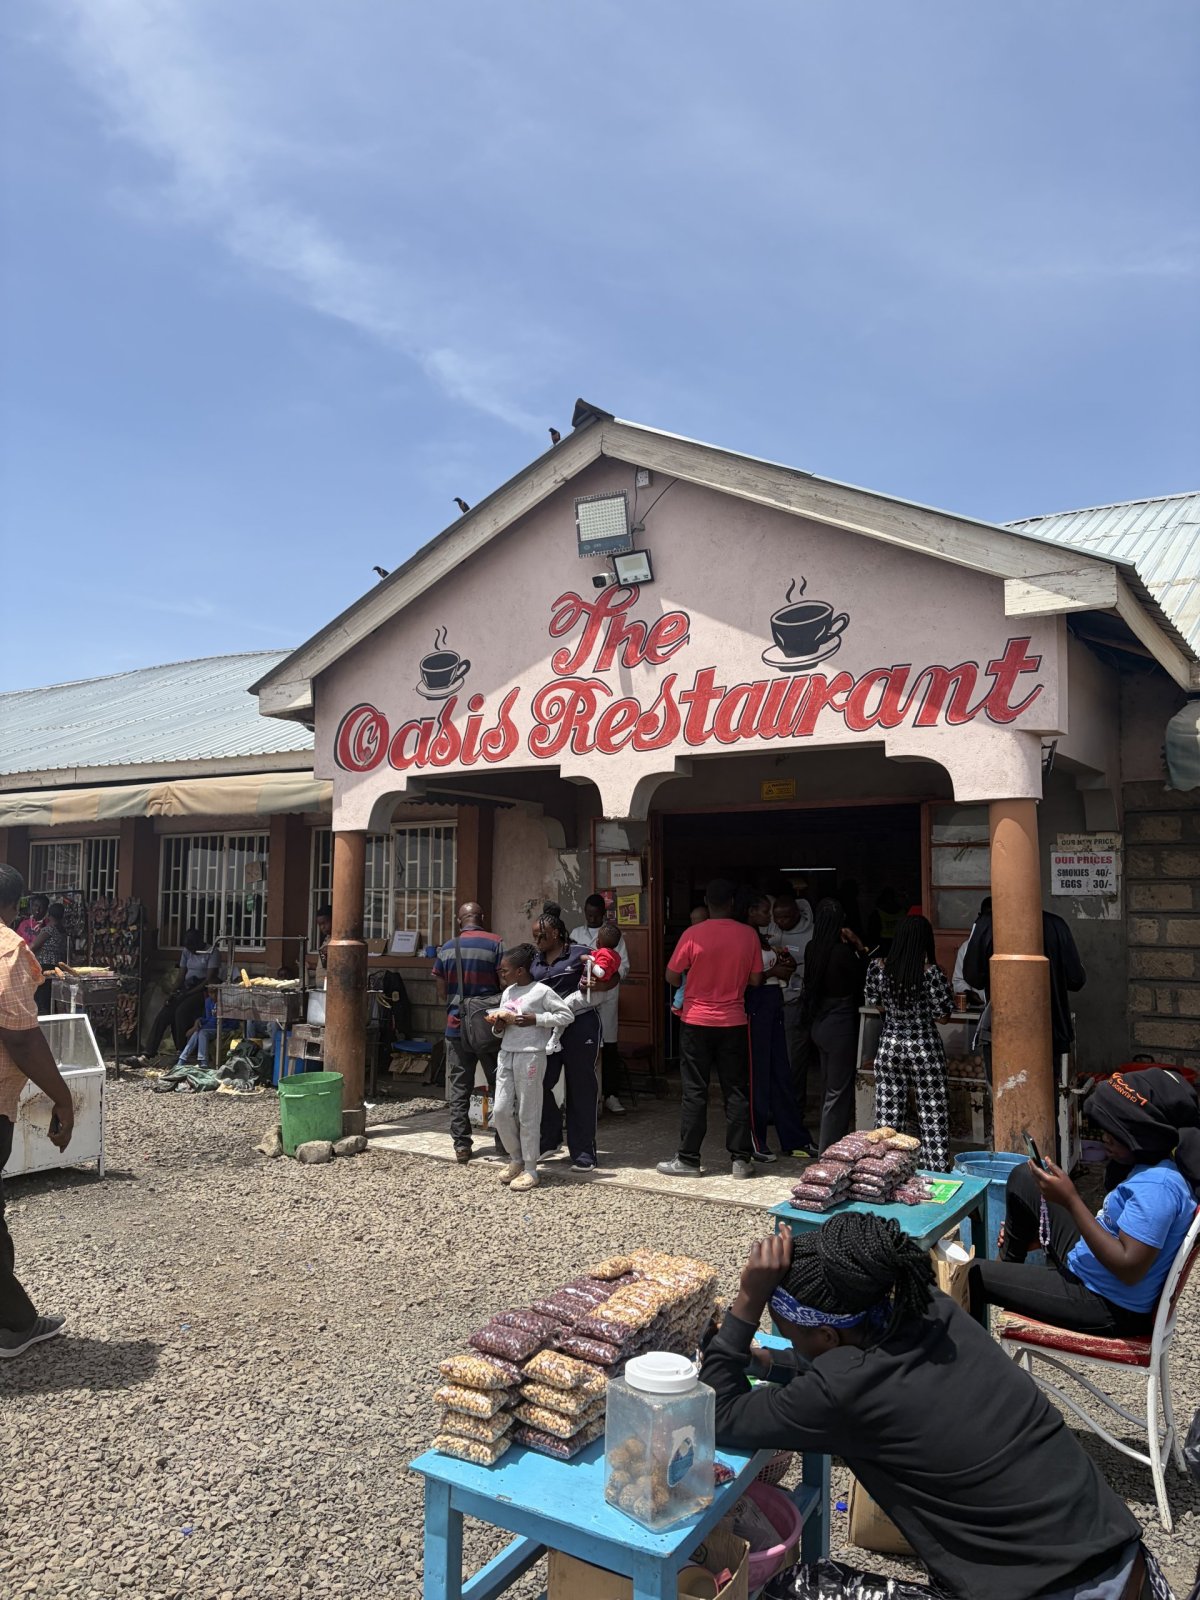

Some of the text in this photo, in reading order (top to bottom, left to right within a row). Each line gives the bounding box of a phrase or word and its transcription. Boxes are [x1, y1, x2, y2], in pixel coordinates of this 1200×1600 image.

[550, 583, 691, 676] The
[333, 636, 1044, 773] Oasis Restaurant
[1055, 855, 1113, 864] OUR PRICES
[1057, 868, 1112, 876] SMOKIES 40/-
[1060, 879, 1112, 888] EGGS 30/-
